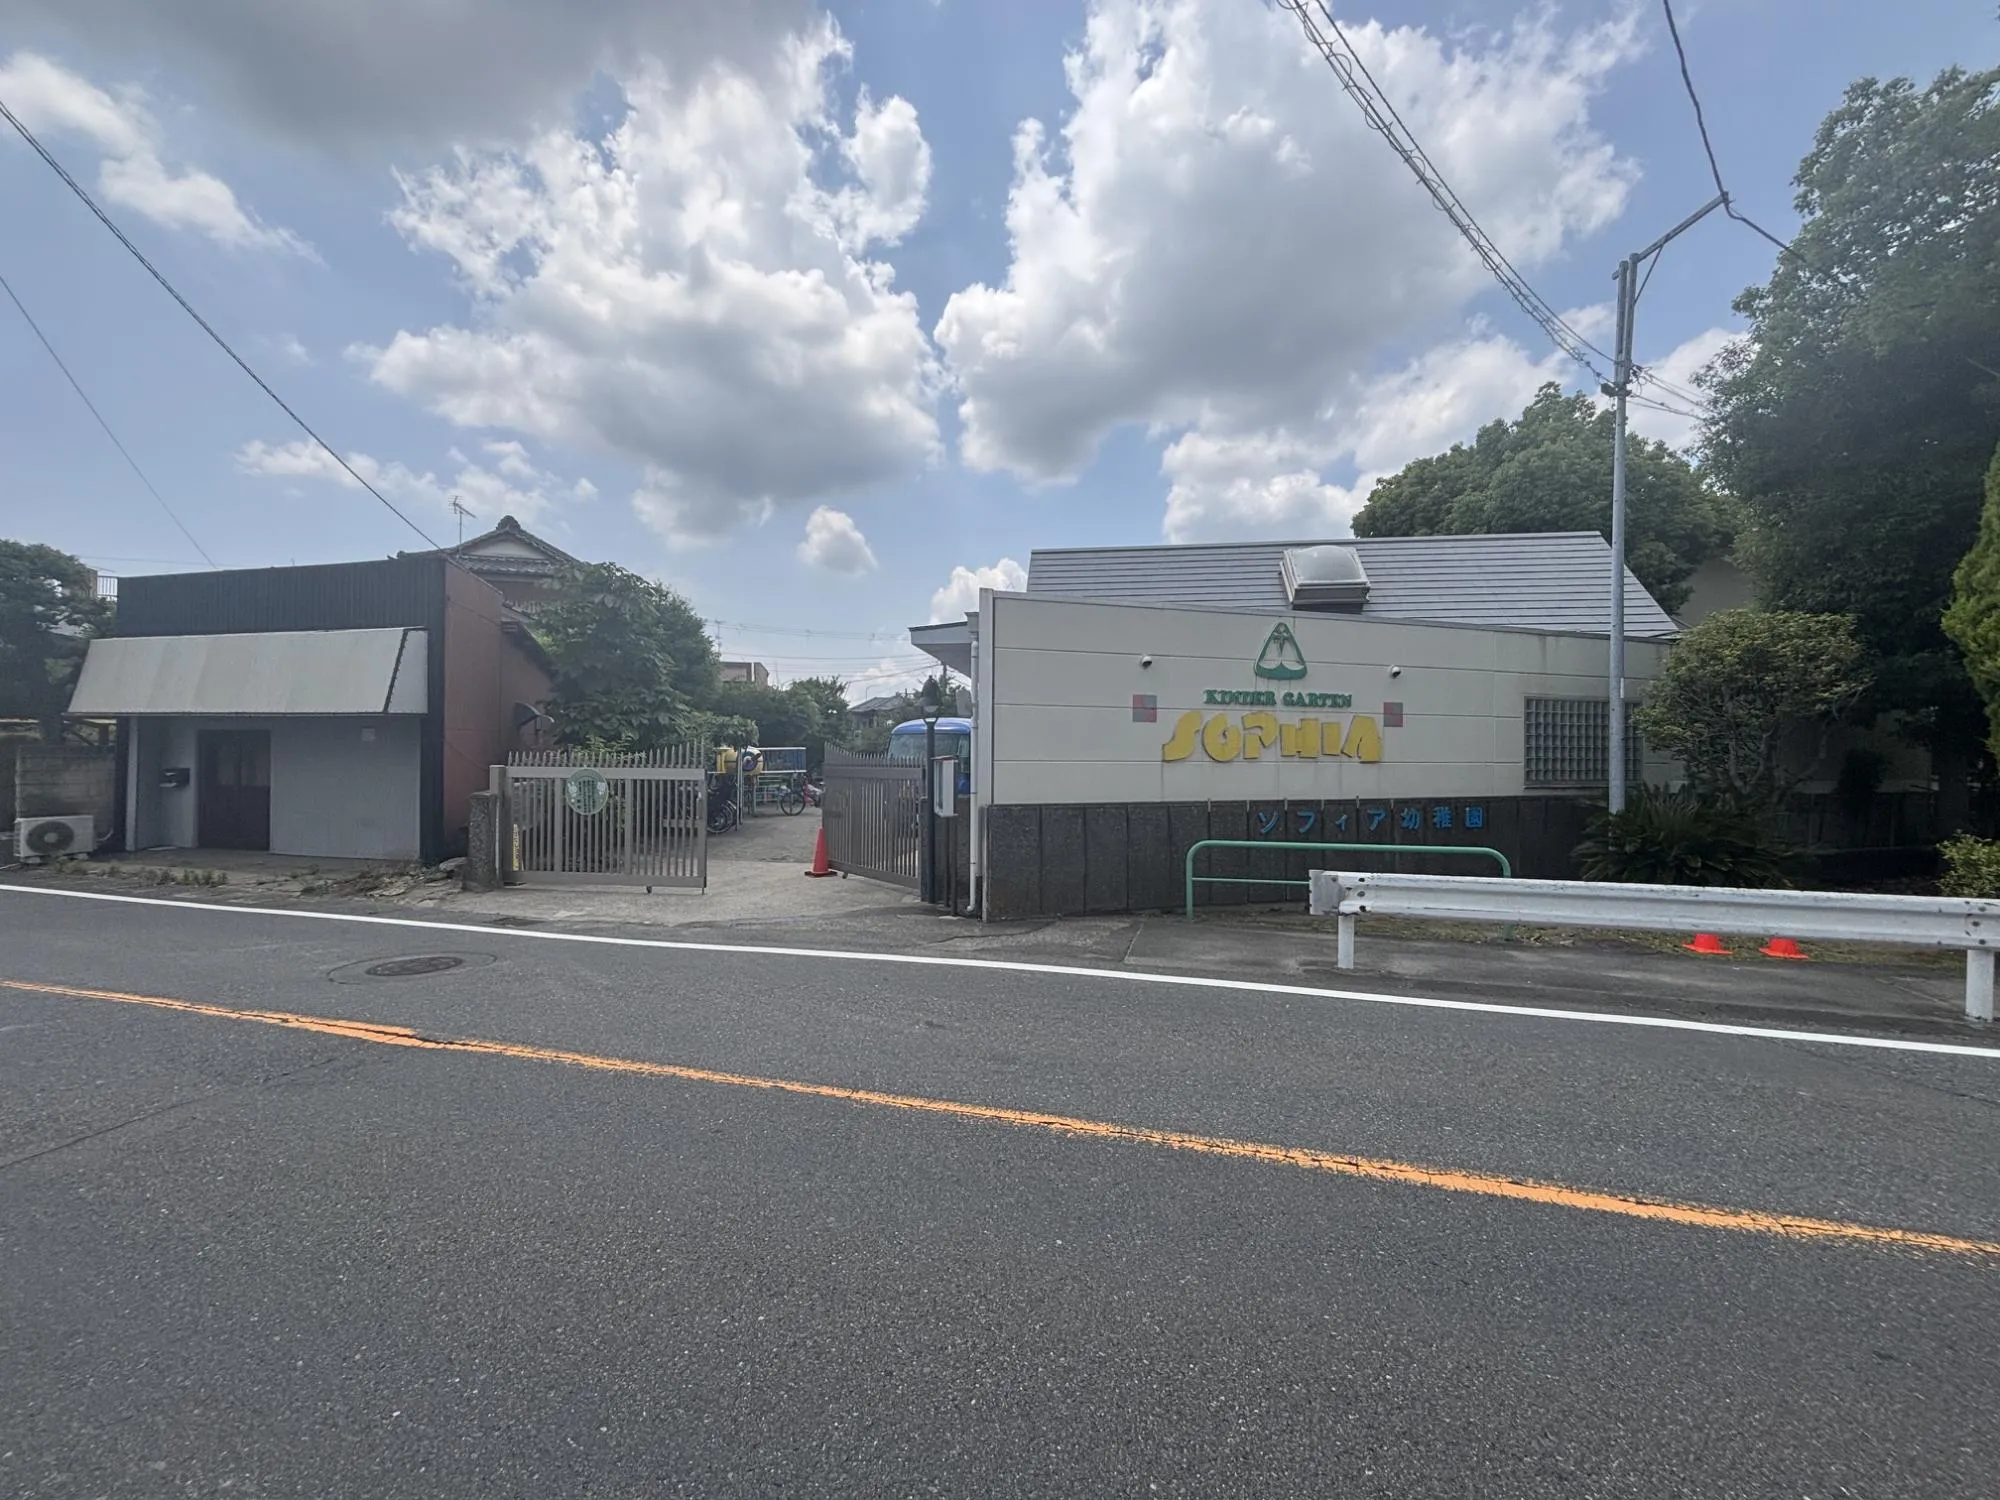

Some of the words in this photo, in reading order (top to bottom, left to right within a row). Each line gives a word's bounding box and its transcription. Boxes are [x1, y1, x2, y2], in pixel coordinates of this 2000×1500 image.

[1204, 690, 1276, 707] KINDER
[1283, 692, 1352, 708] GARTEN
[1162, 711, 1382, 763] SOPHIA
[1258, 806, 1484, 834] ソフィア幼稚園
